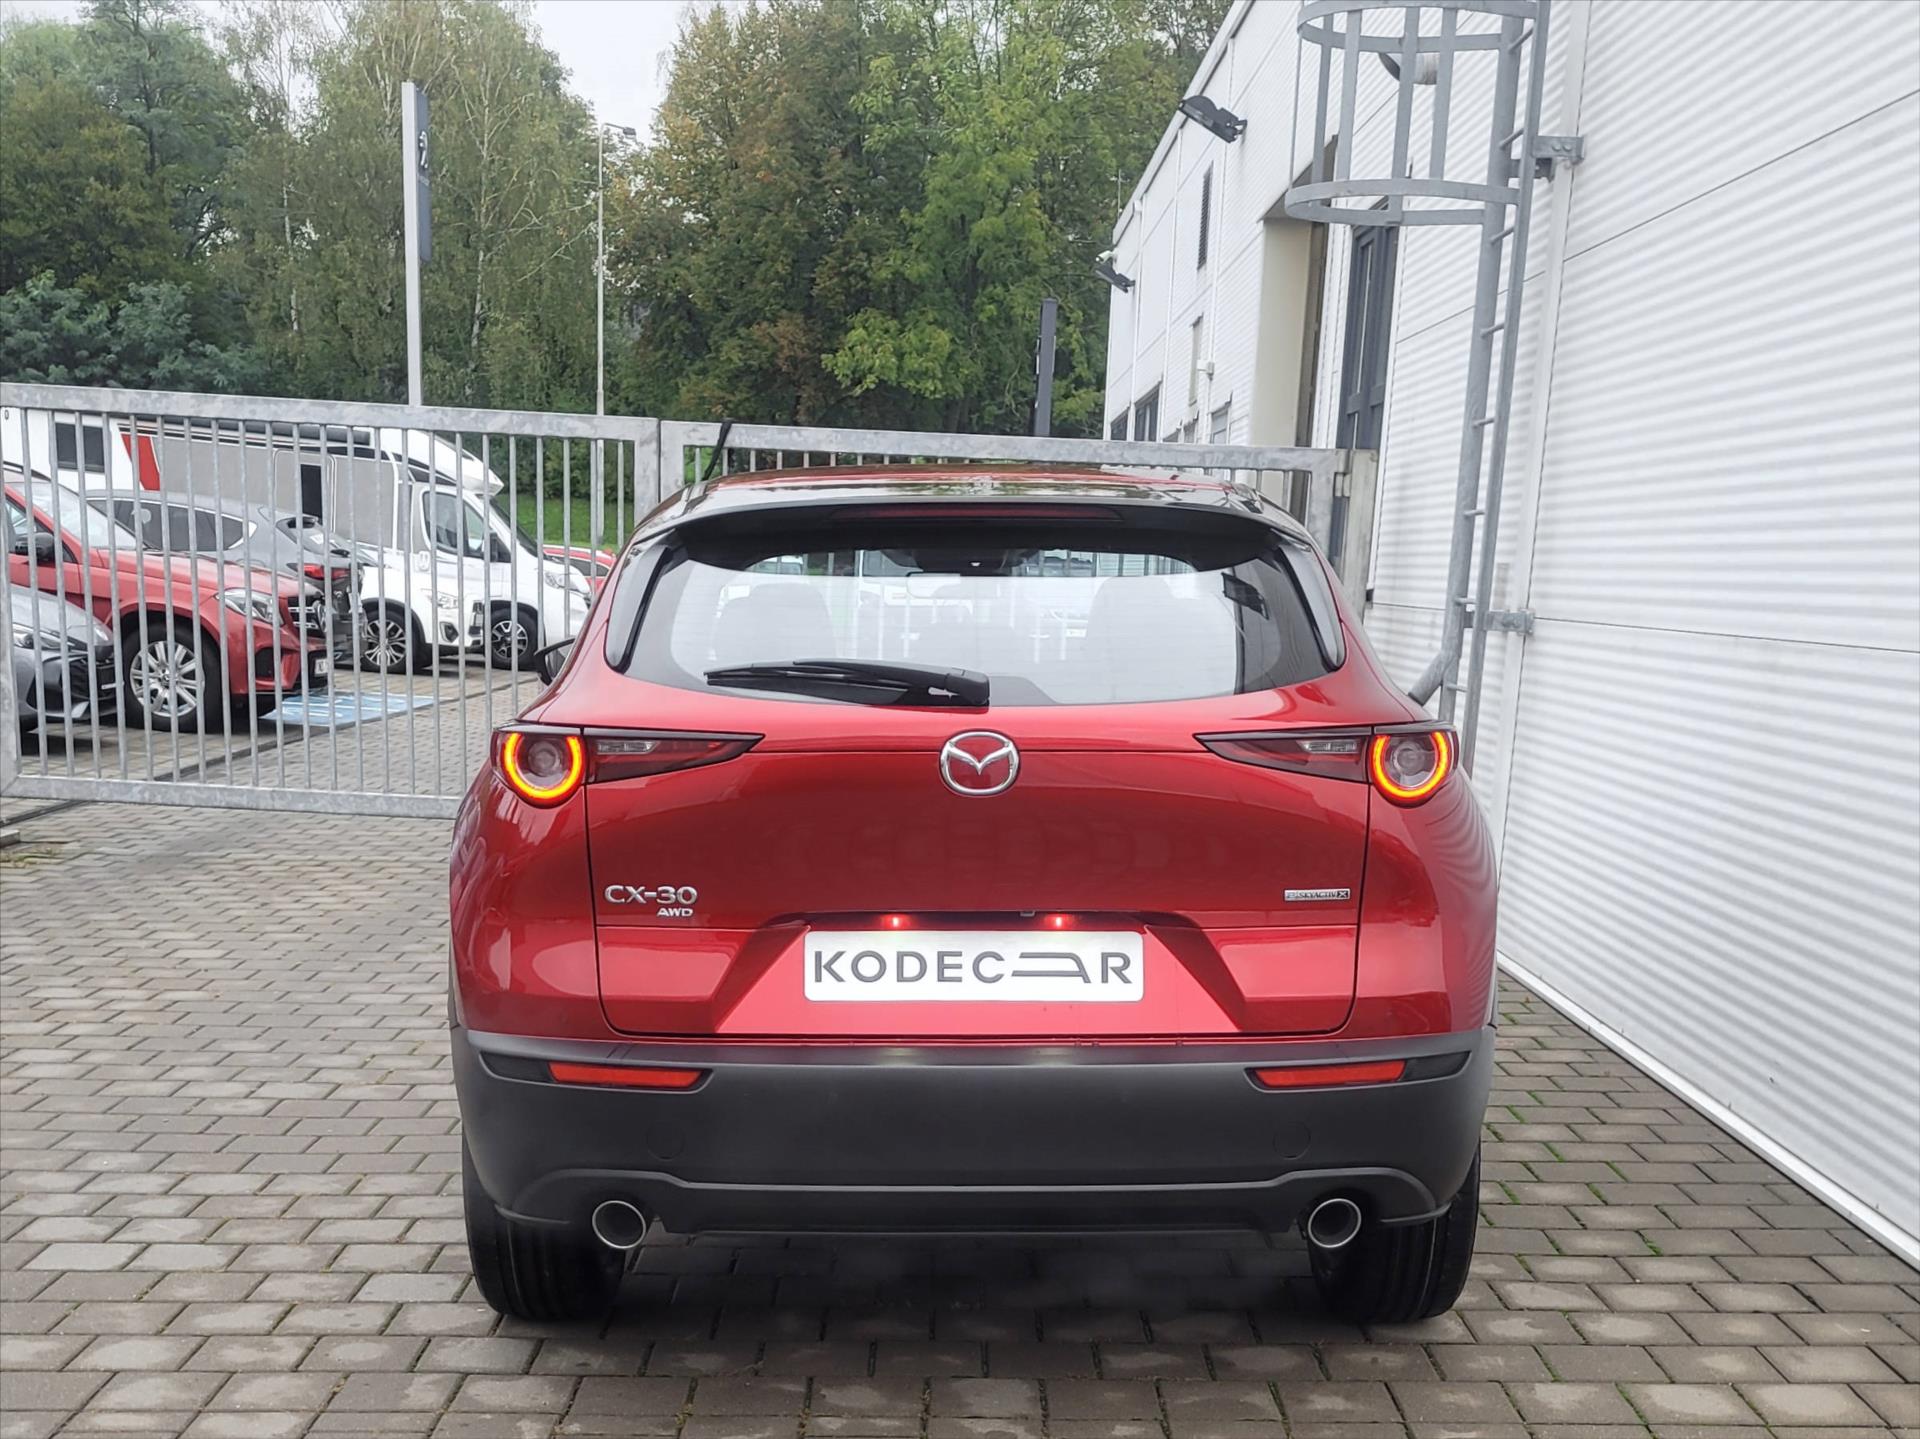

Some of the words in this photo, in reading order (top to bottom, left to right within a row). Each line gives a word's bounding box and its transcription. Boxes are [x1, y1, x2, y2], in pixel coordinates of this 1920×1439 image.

[604, 884, 698, 905] CX-30
[656, 907, 694, 917] AWD
[814, 950, 1133, 984] KODECAR
